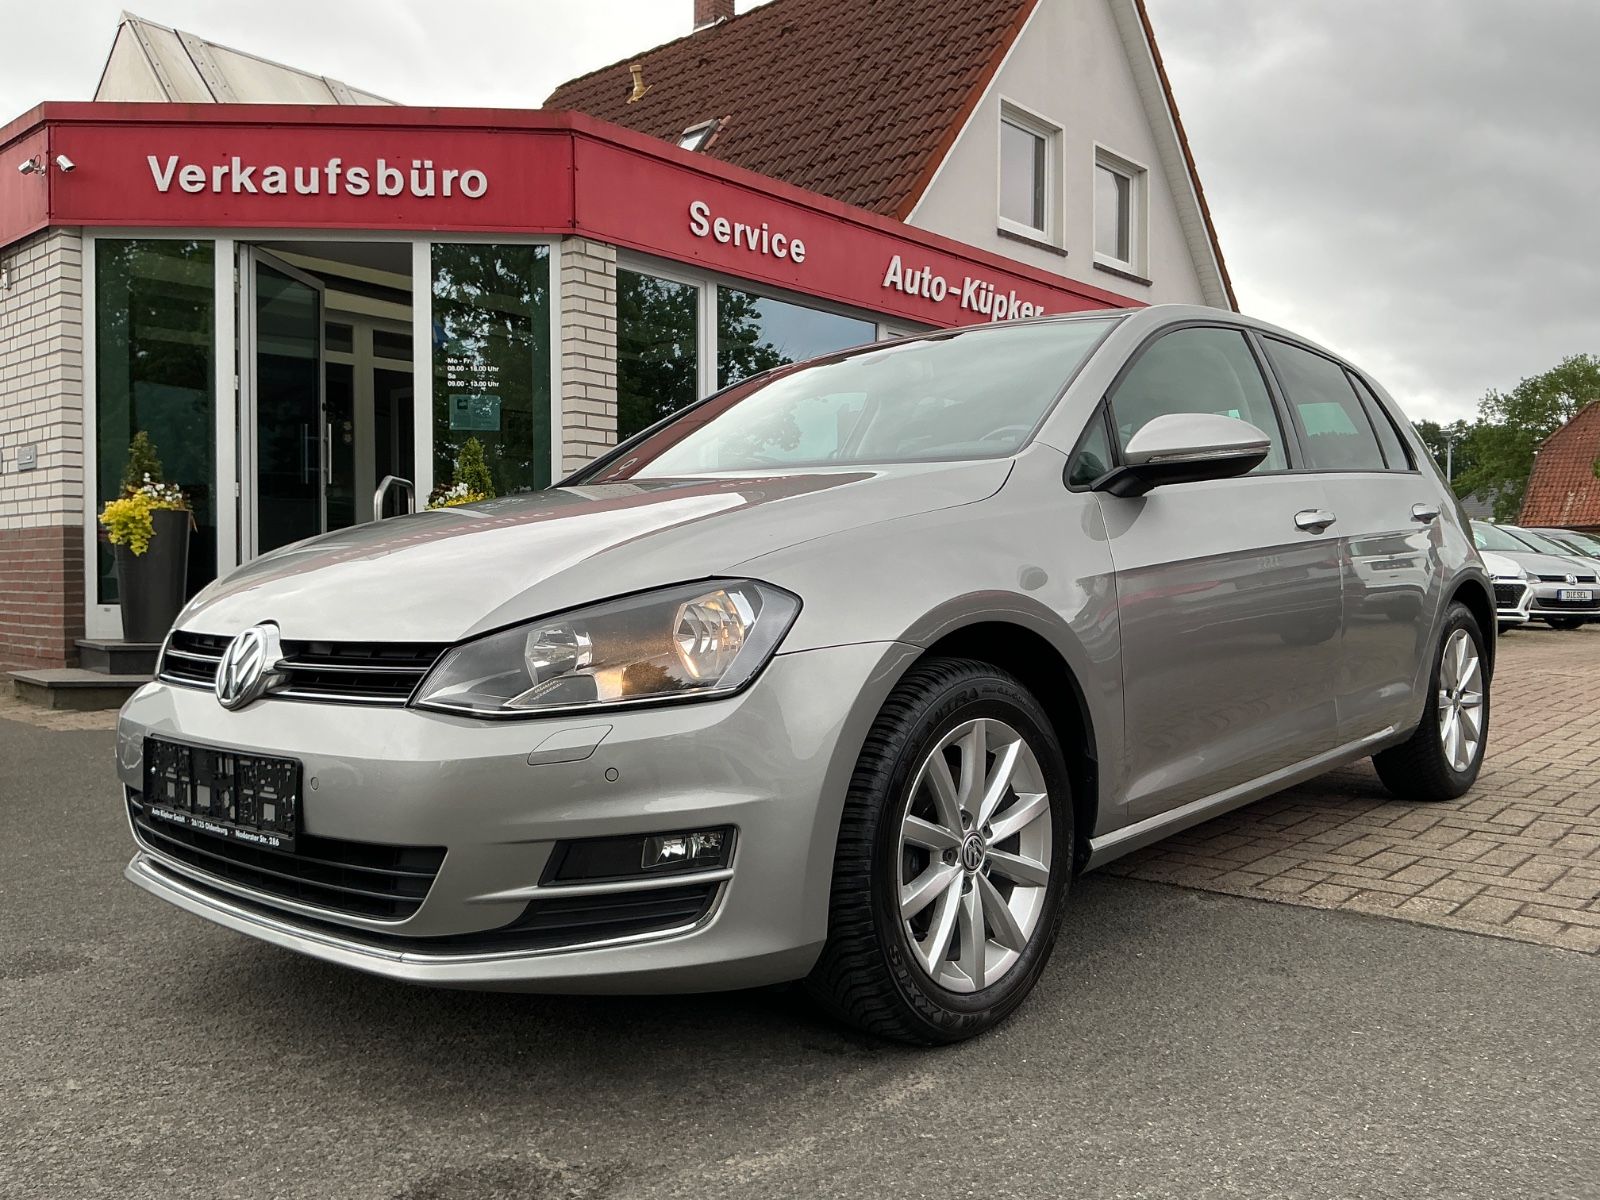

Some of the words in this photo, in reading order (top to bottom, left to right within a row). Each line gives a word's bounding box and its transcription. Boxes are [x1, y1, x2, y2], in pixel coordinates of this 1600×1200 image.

[147, 154, 490, 200] Verkaufsbüro
[689, 200, 807, 265] Service
[882, 255, 1044, 321] Auto-Küpker
[1566, 591, 1588, 599] DIESEL
